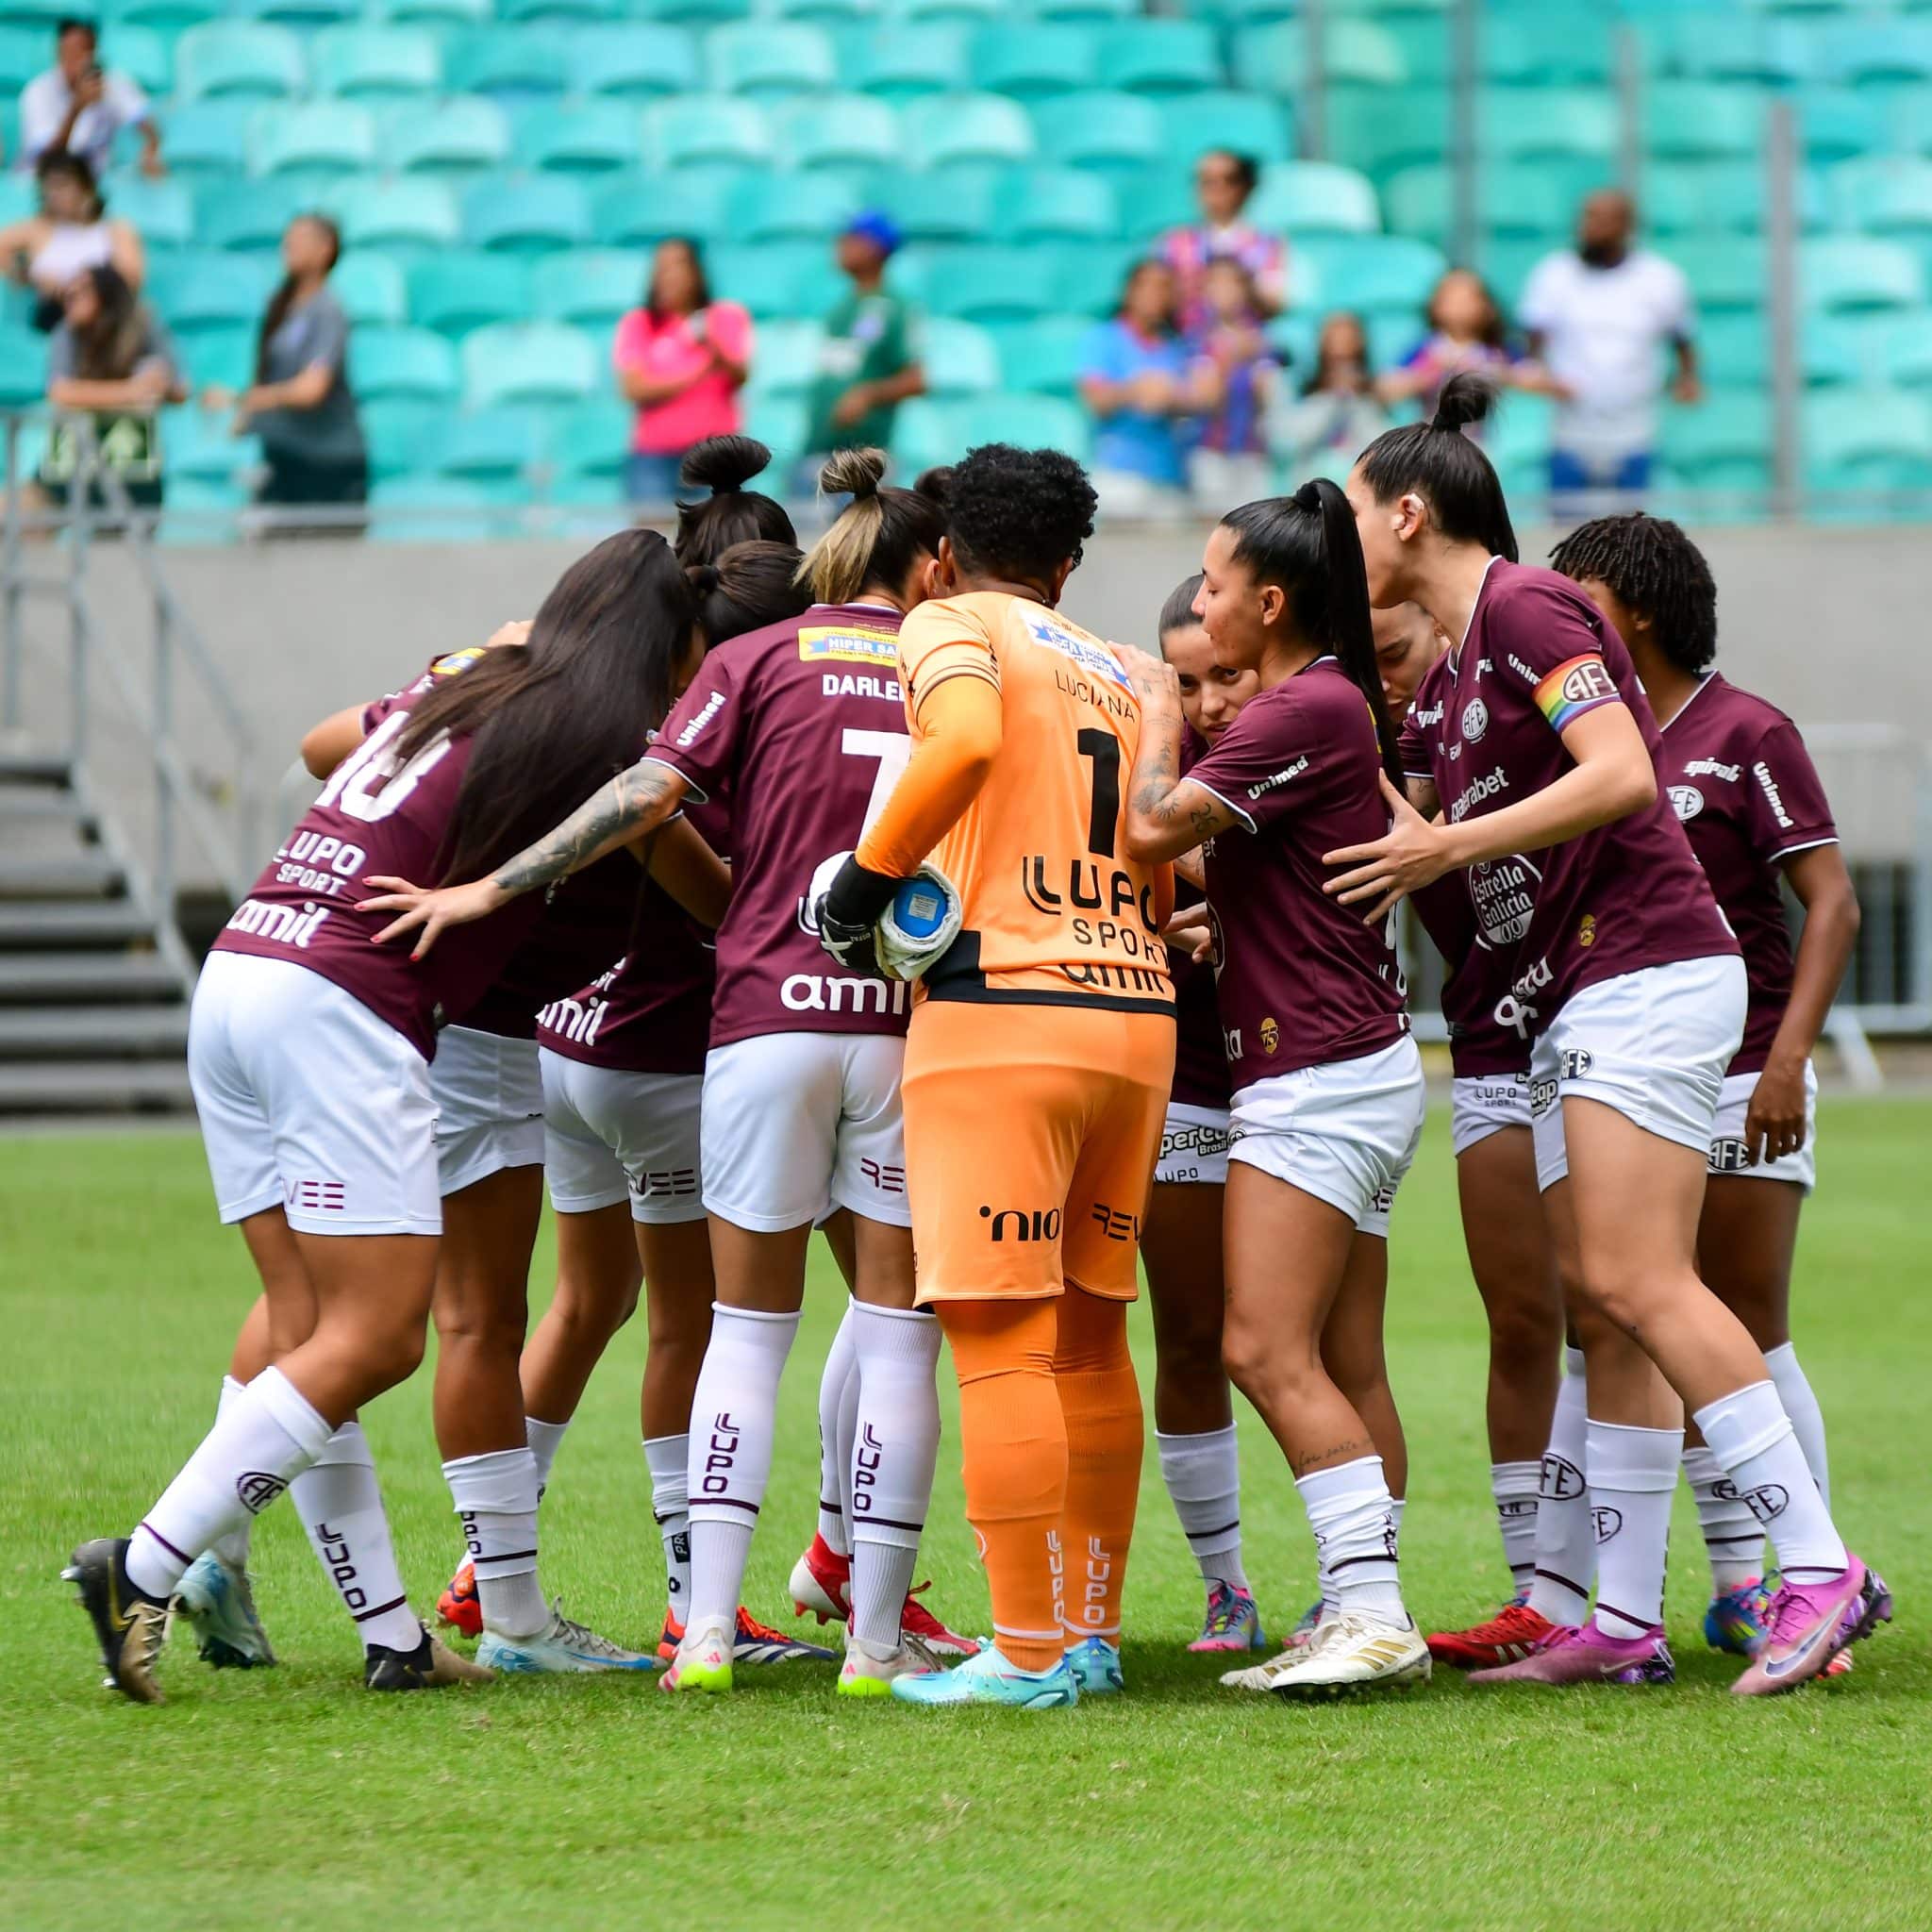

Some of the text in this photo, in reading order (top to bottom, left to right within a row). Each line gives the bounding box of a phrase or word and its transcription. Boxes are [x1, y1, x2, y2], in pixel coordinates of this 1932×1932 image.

[876, 642, 898, 657] SA
[841, 727, 912, 847] 7
[1077, 727, 1120, 859] 1
[1247, 755, 1309, 801] Unimed
[1753, 761, 1794, 828] Unimed
[276, 863, 347, 895] SPORT
[1473, 865, 1526, 904] Estrella
[1481, 890, 1533, 928] Galicia
[780, 974, 905, 1015] ami
[1198, 1139, 1227, 1156] Brasil
[703, 1413, 741, 1494] LUPO
[853, 1421, 883, 1511] LUPO
[315, 1523, 368, 1610] LUPO
[1084, 1535, 1111, 1624] LUPO
